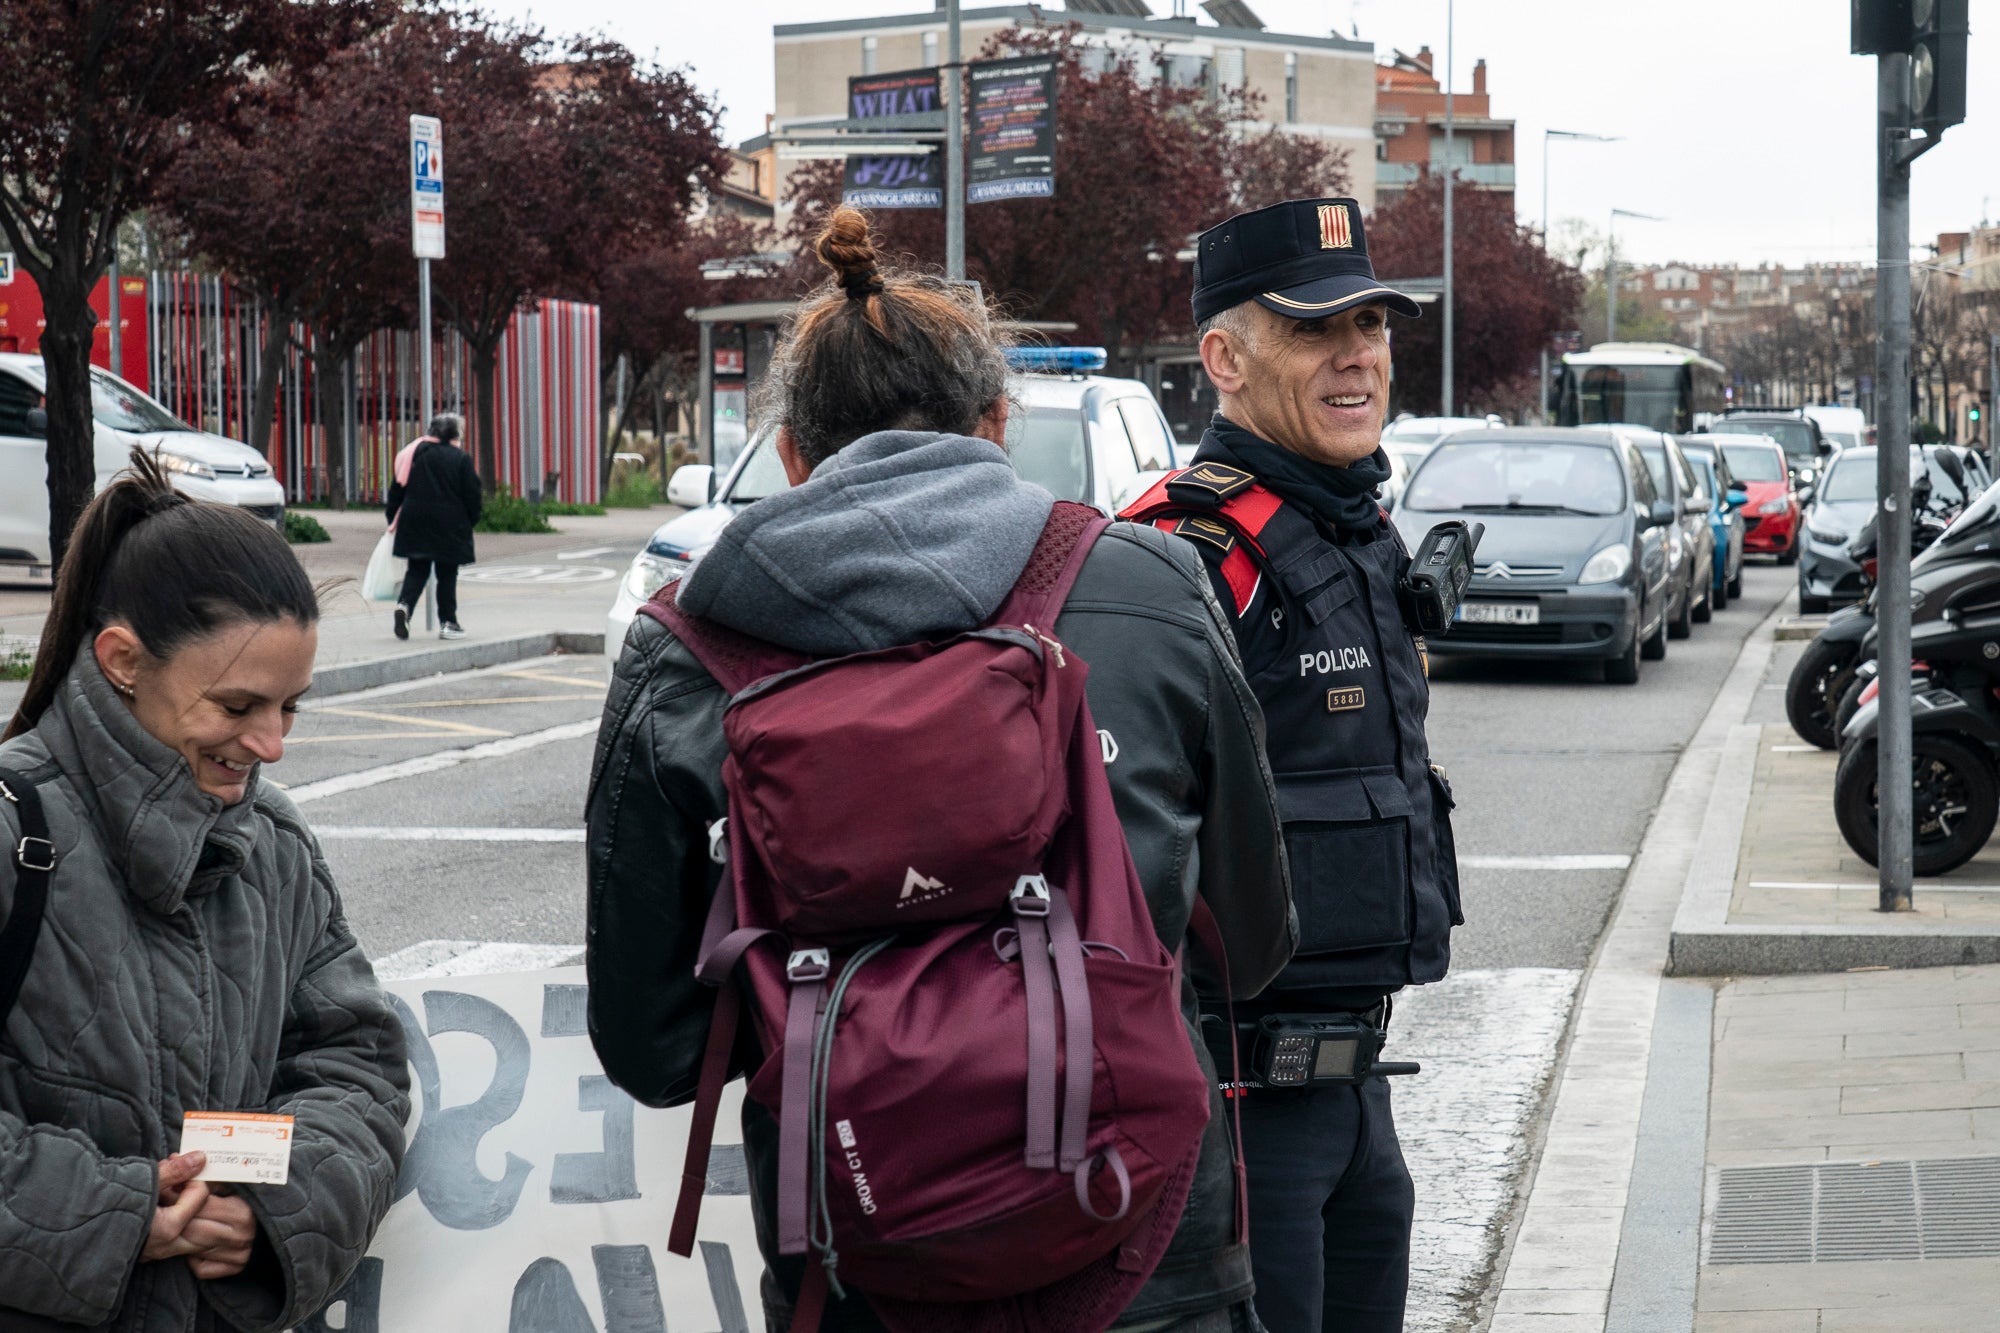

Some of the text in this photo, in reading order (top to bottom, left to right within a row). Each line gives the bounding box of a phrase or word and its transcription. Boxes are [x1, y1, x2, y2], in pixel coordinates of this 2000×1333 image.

[853, 86, 937, 120] WHAT
[417, 143, 427, 174] P
[1299, 646, 1371, 677] POLICIA
[1333, 693, 1360, 706] 5887
[845, 1150, 862, 1170] CT
[852, 1172, 878, 1216] CROW
